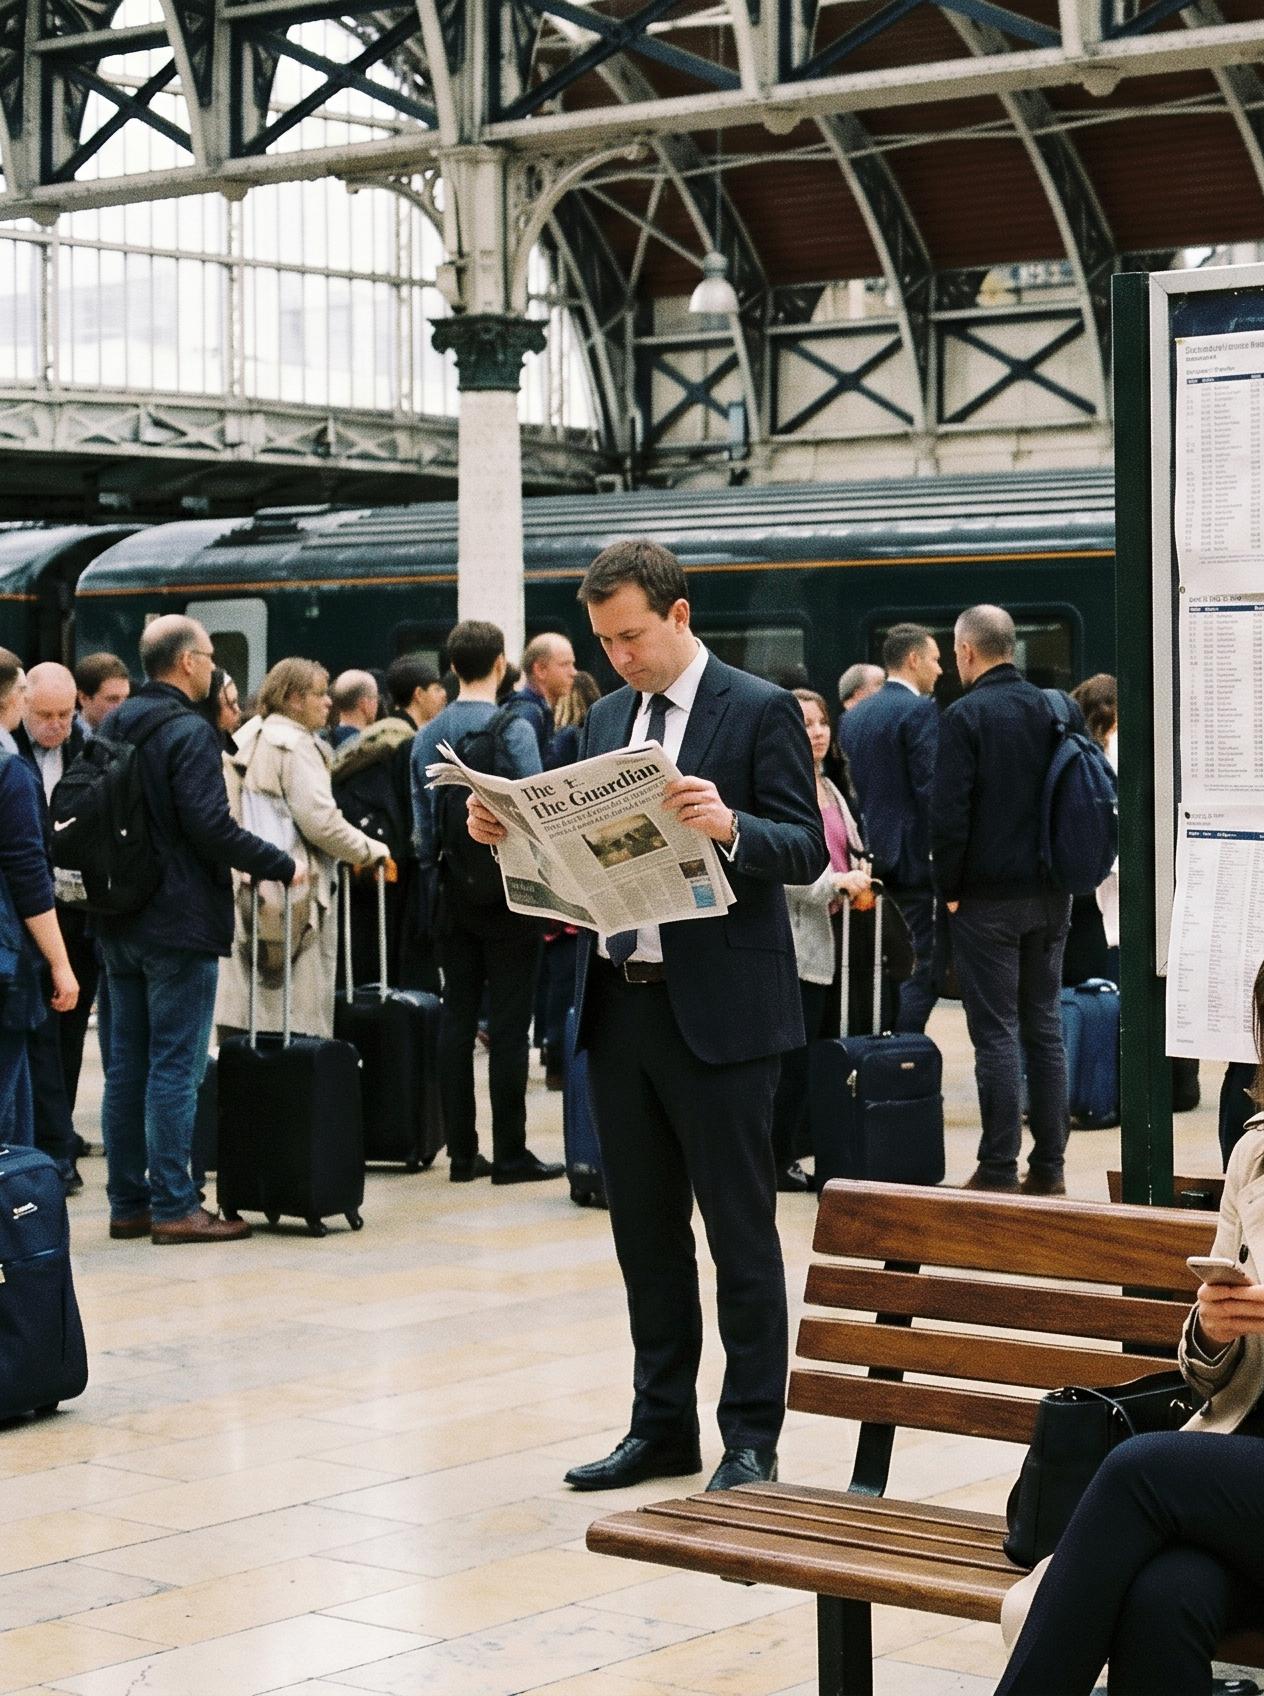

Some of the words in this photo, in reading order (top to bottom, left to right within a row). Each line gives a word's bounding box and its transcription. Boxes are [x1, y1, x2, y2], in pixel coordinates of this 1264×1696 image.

[521, 784, 556, 802] The
[531, 801, 568, 819] The
[568, 763, 661, 807] Guardian
